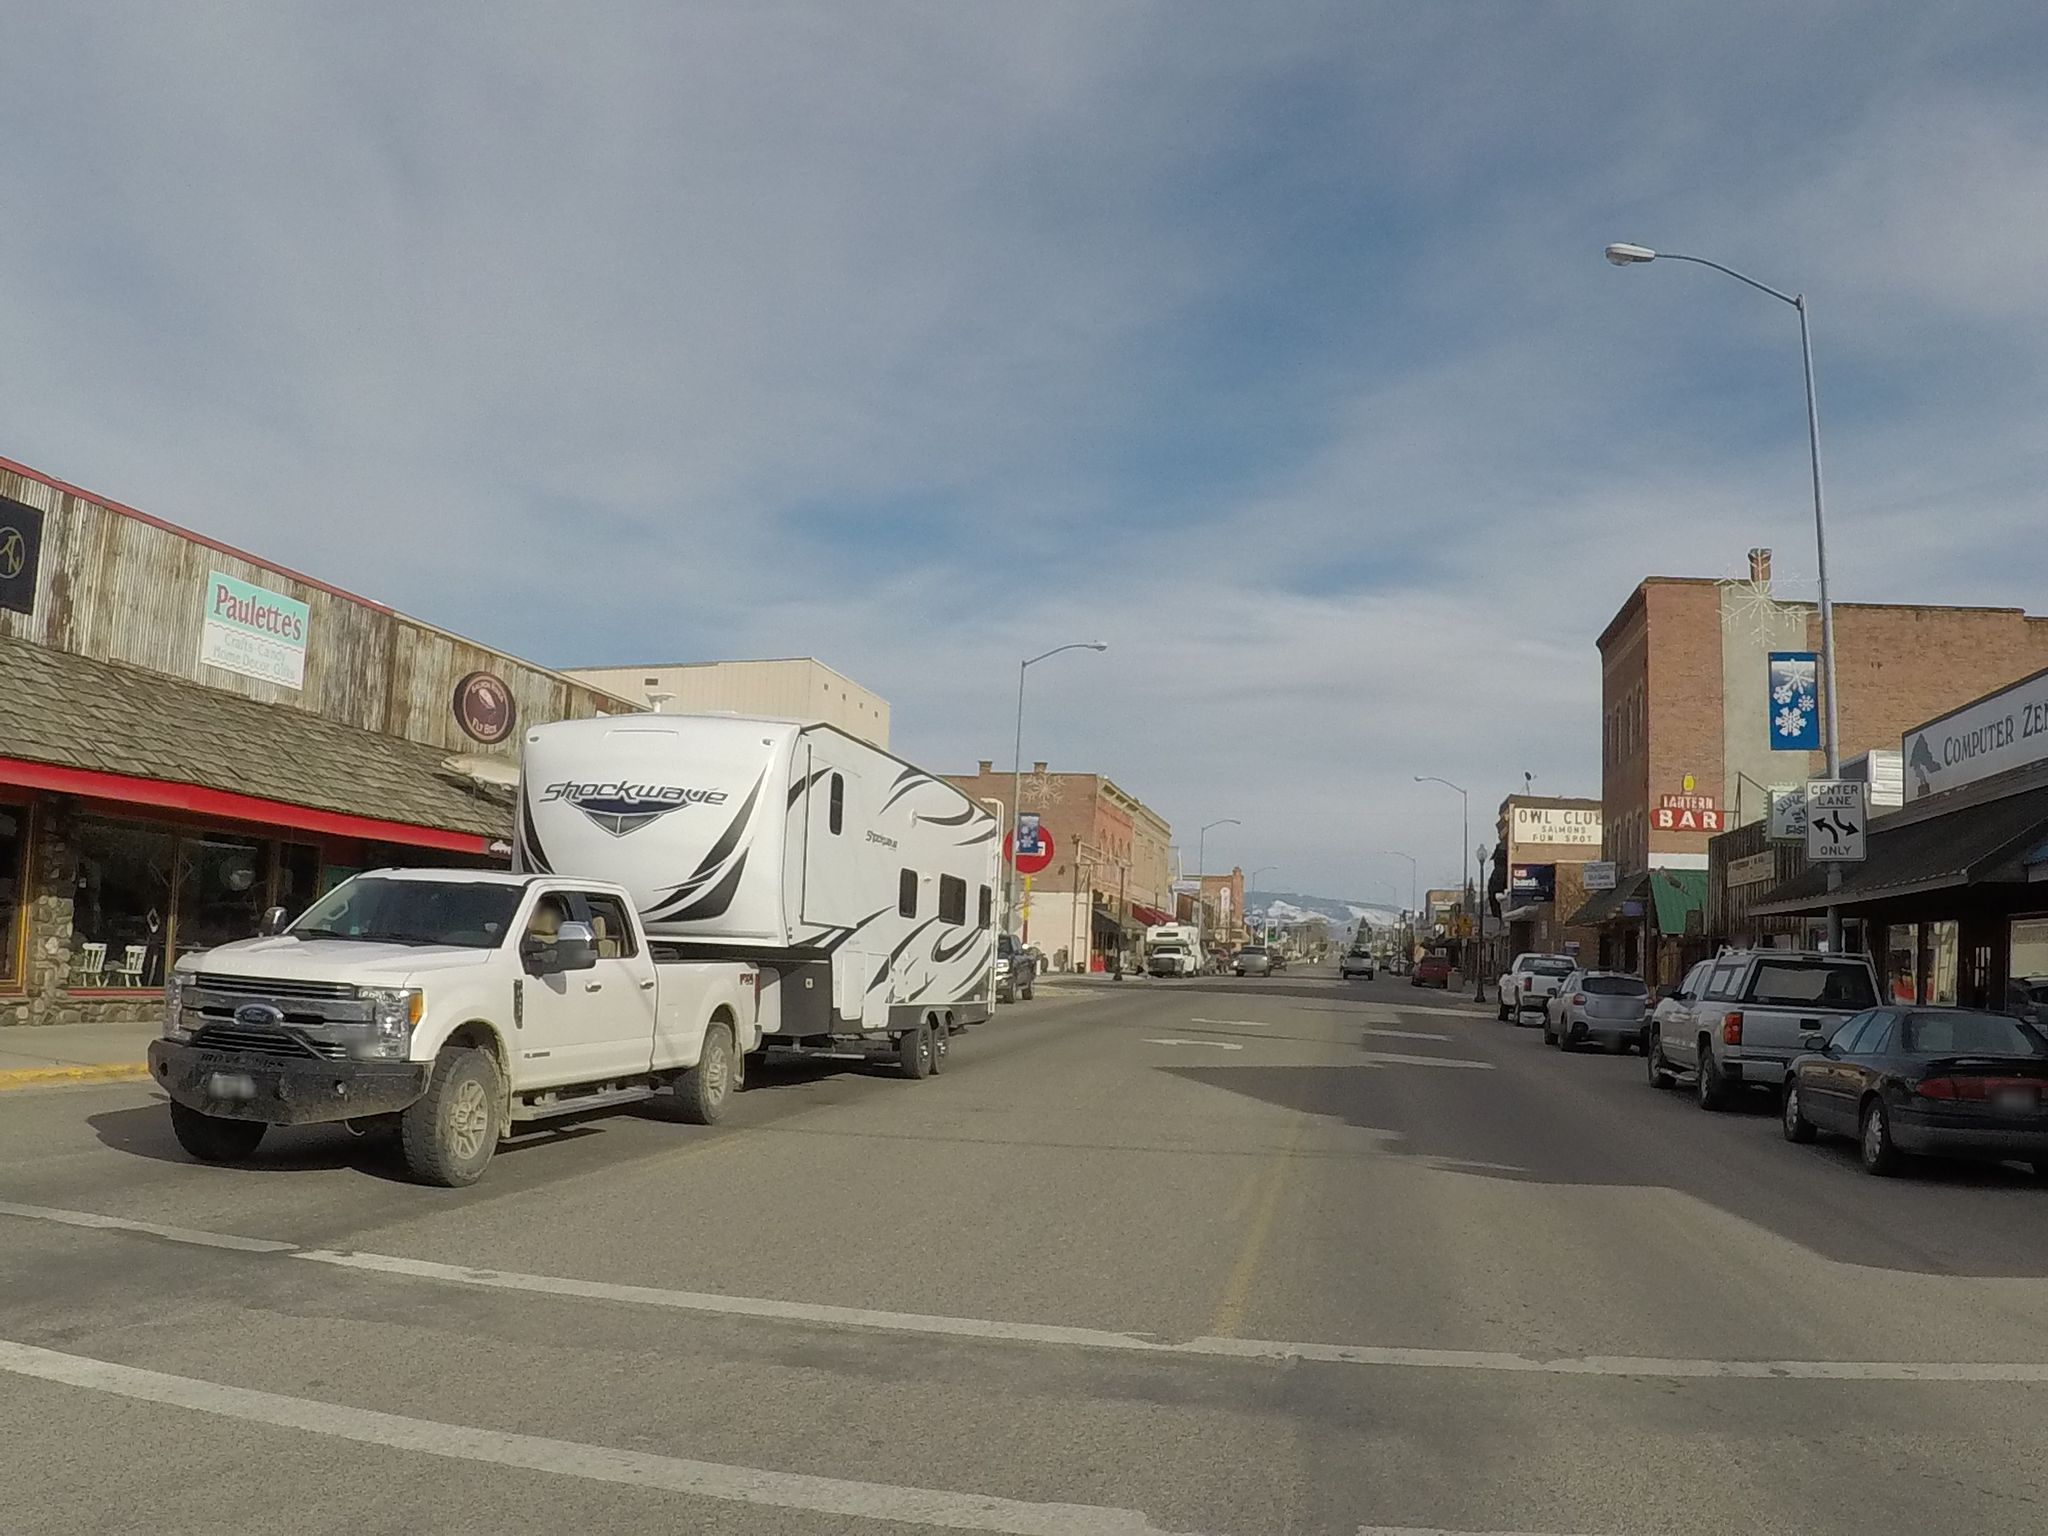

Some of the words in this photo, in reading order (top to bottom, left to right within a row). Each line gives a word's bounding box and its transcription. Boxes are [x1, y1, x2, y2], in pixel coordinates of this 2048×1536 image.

[214, 584, 302, 641] Paulette's
[1811, 785, 1858, 795] CENTER
[1663, 795, 1714, 810] LANTERN
[1818, 796, 1853, 806] LANE
[1519, 810, 1552, 824] OWL
[1659, 810, 1717, 829] BAR
[1532, 833, 1554, 842] FUN
[1564, 834, 1593, 843] SPOT
[1820, 846, 1852, 856] ONLY
